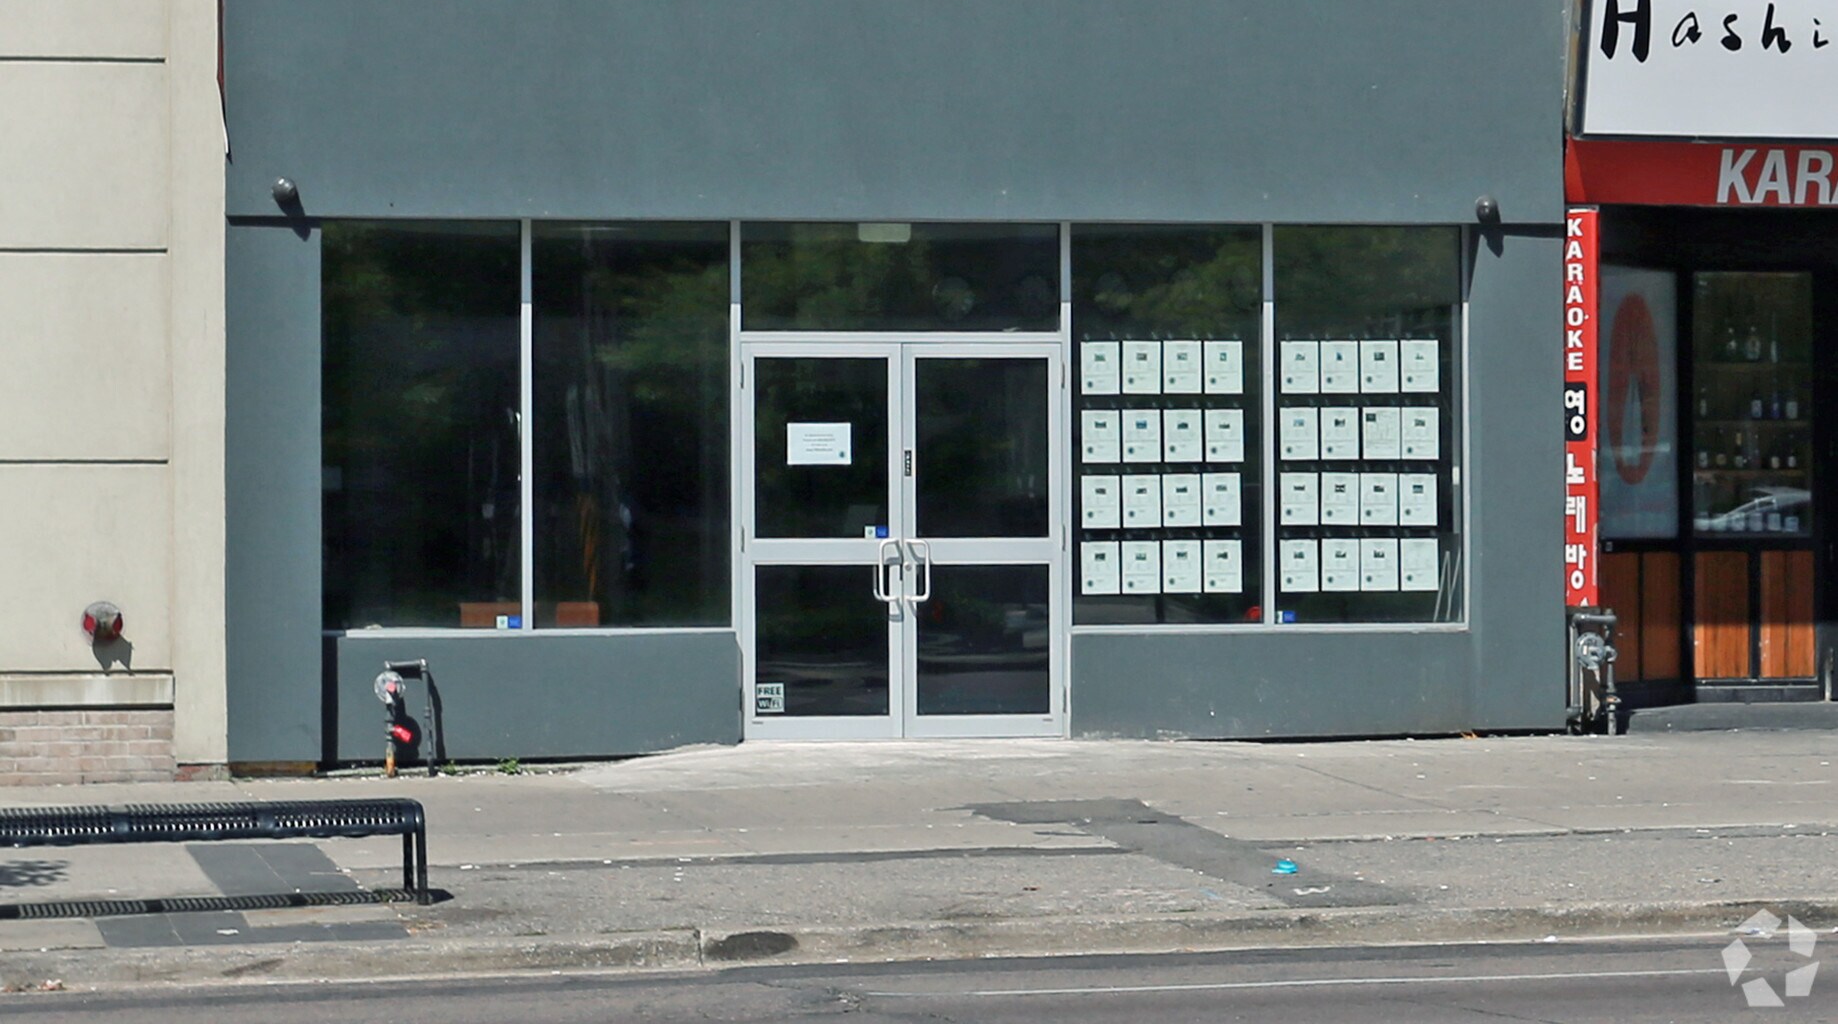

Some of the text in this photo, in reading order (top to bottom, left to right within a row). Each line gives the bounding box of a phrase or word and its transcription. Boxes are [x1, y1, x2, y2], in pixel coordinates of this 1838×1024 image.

[1716, 148, 1838, 205] KAR
[1566, 218, 1584, 371] KARAOKE
[758, 686, 781, 695] FREE
